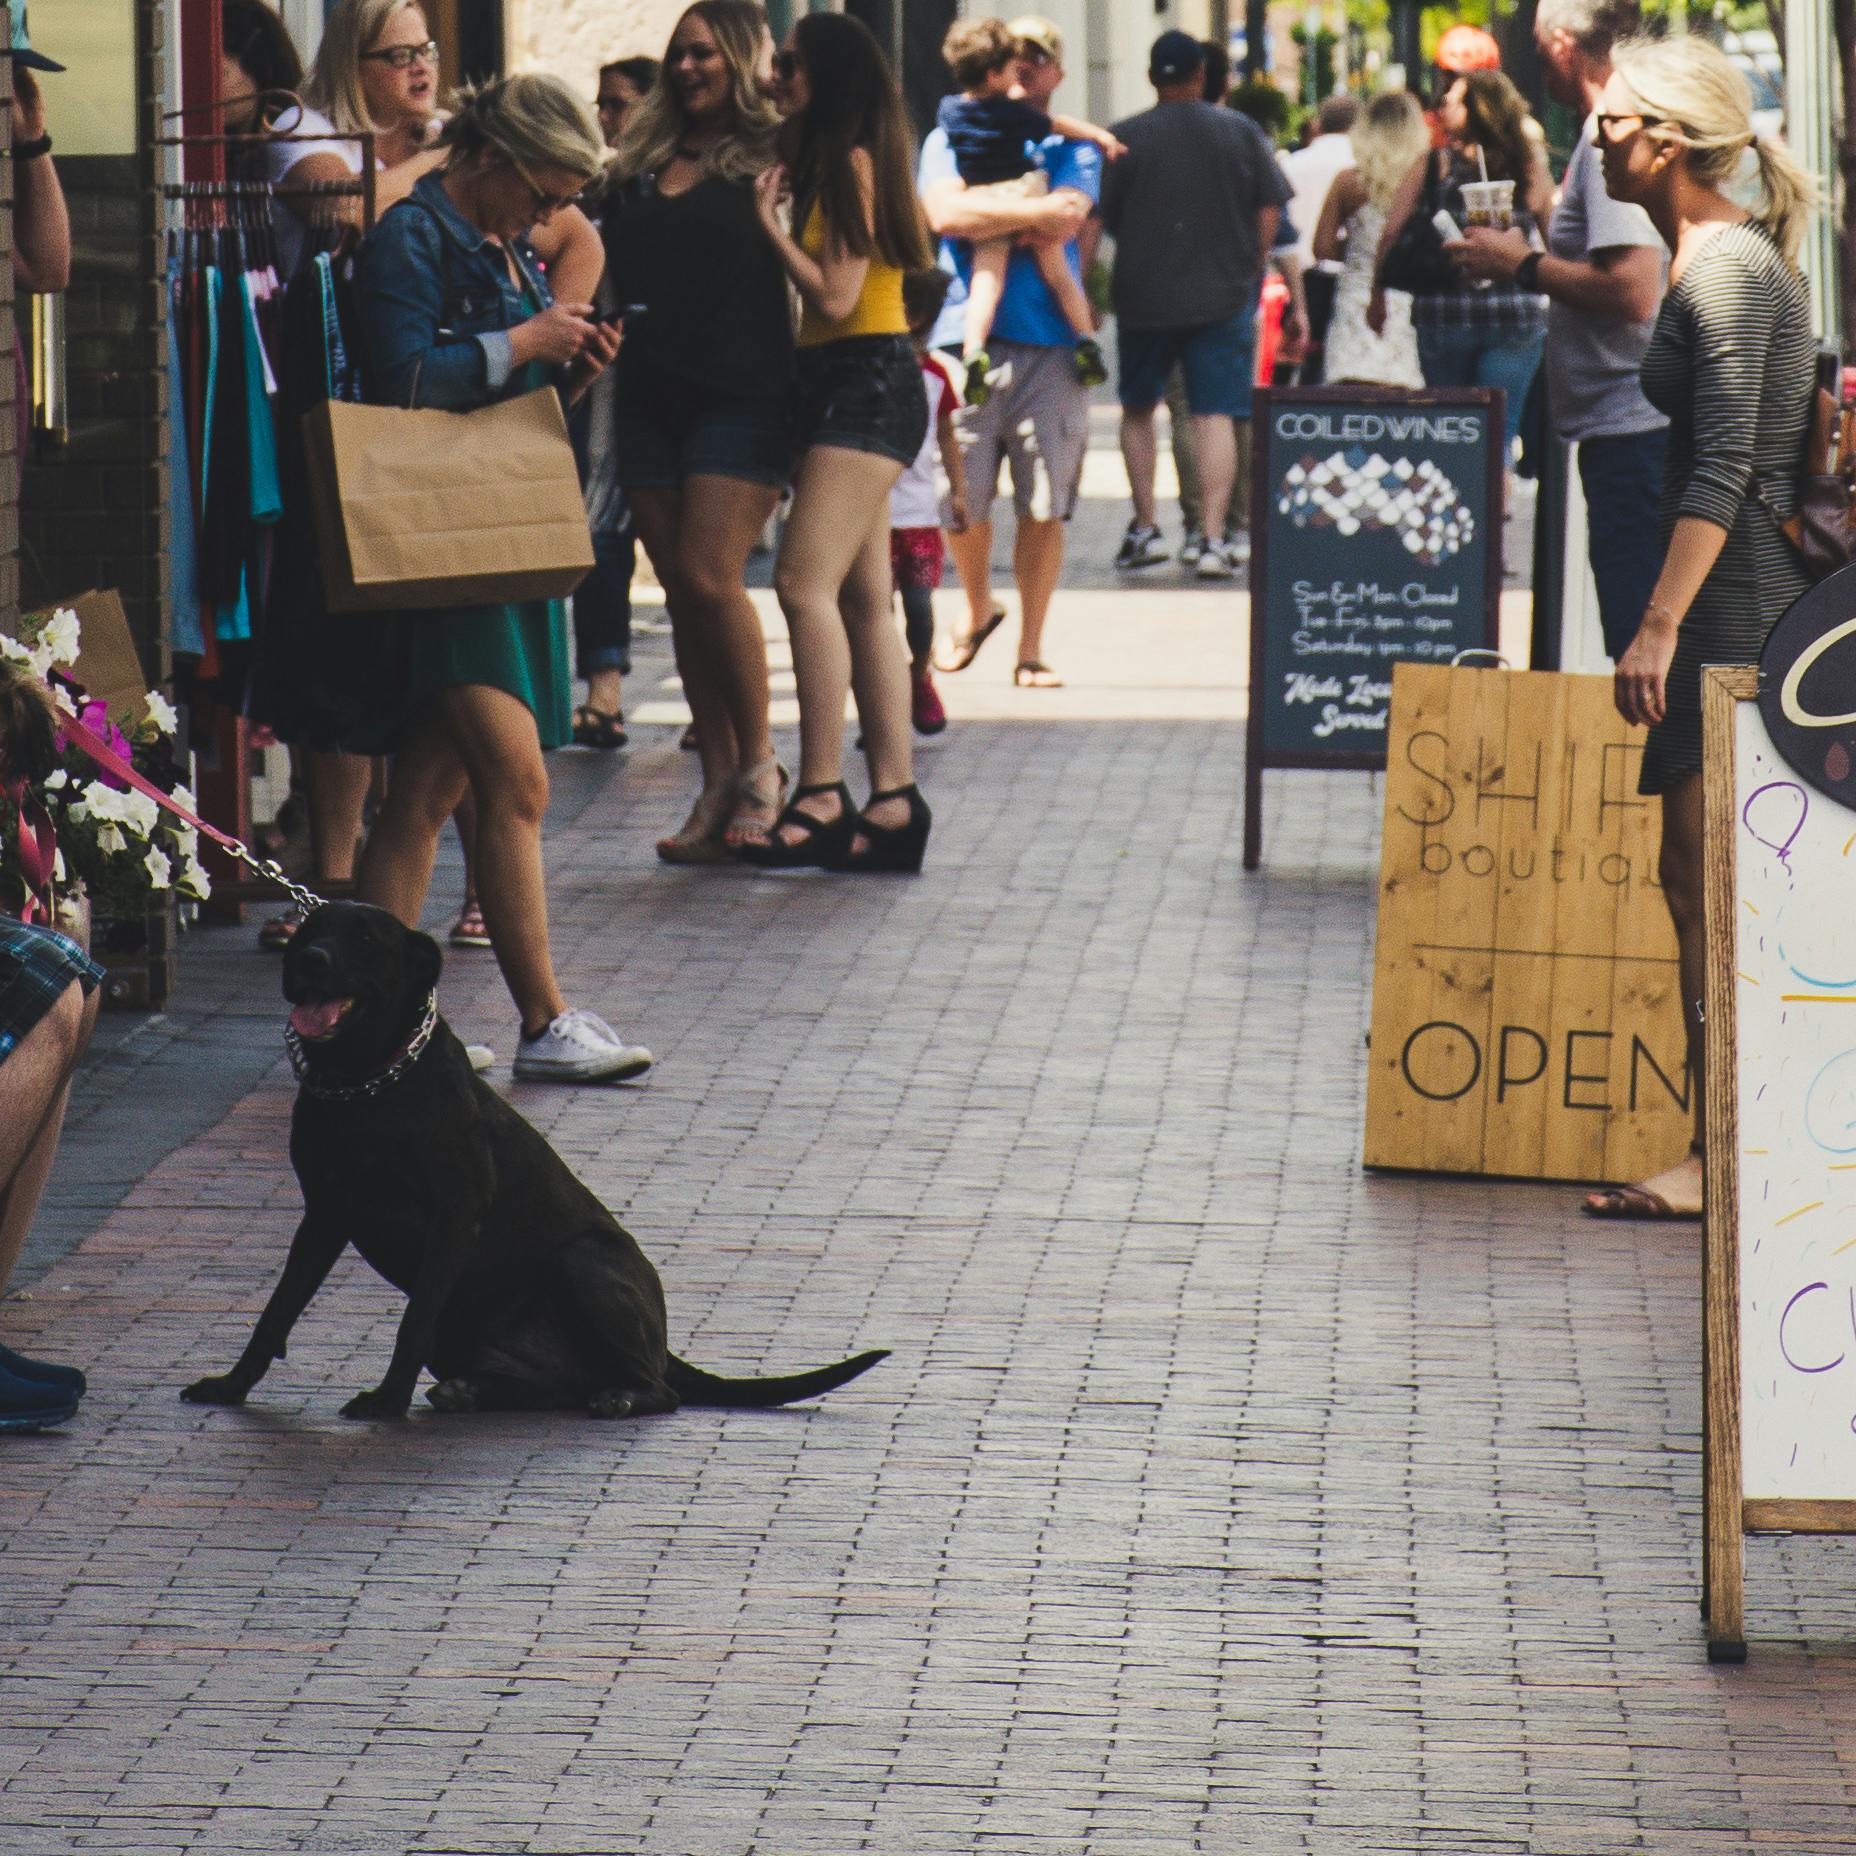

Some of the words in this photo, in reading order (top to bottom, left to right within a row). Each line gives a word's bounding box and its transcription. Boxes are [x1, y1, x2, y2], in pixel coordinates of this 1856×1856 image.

[1275, 413, 1385, 441] COILED
[1386, 415, 1481, 443] WINES
[1397, 730, 1647, 834] SHIF
[1401, 1021, 1693, 1113] OPEN
